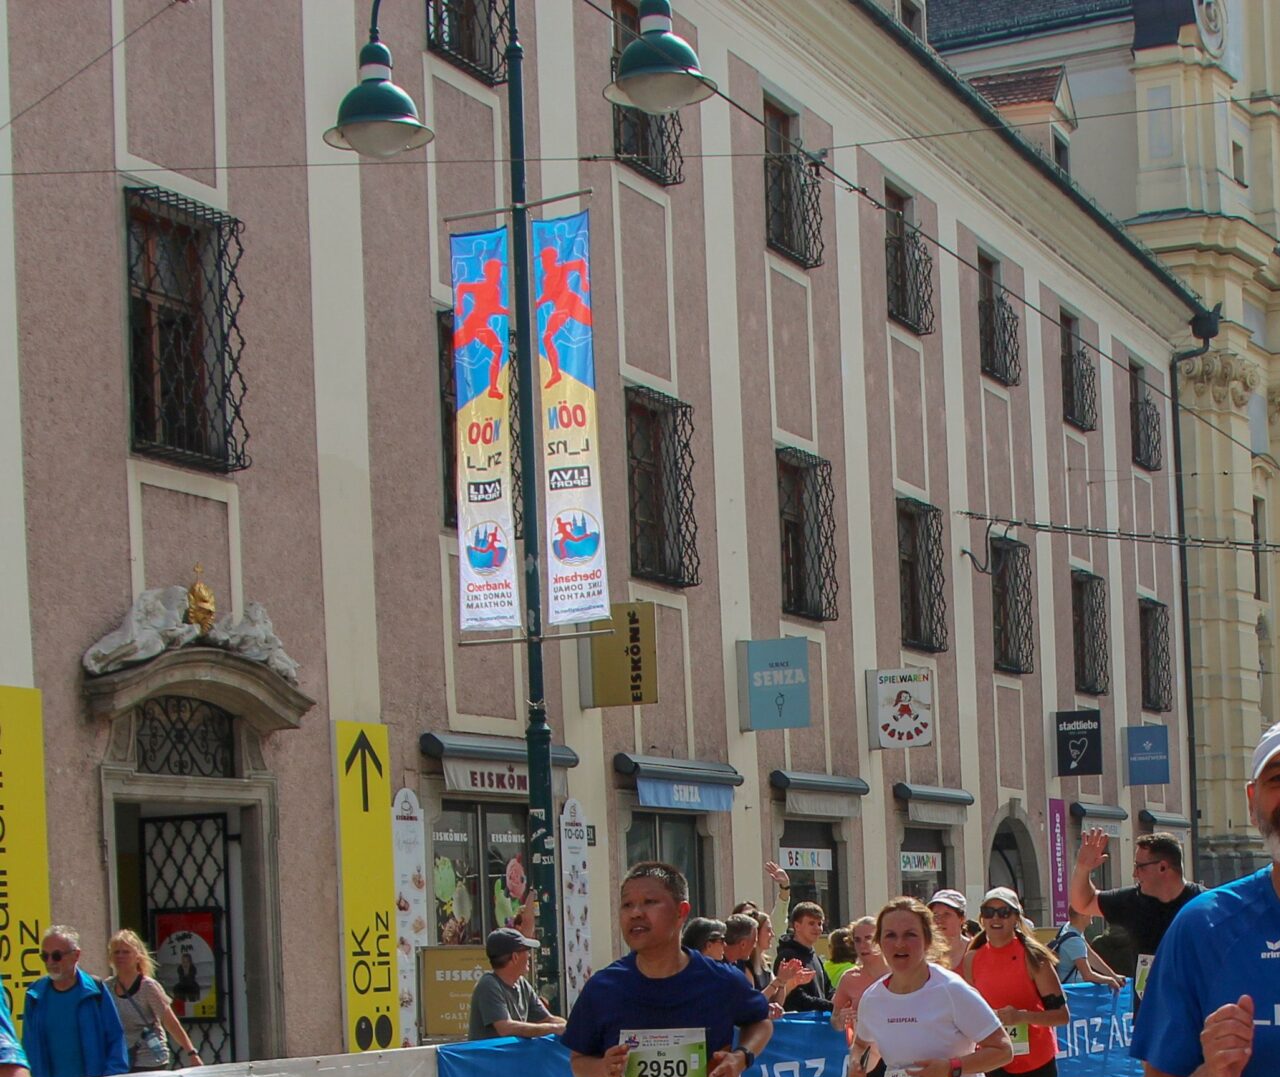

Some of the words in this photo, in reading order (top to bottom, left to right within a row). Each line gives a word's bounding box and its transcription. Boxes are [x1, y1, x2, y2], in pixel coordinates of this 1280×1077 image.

[483, 592, 512, 600] DONAU
[753, 668, 806, 687] SENZA
[879, 673, 929, 684] SPIELWAREN
[1058, 719, 1098, 731] stadtliebe
[470, 765, 528, 790] EISKÖN
[672, 784, 700, 802] SENZA
[491, 830, 526, 843] EISKÖNIG
[564, 828, 584, 840] TO-GO
[1055, 812, 1064, 892] stadtliebe
[352, 926, 371, 994] OK
[373, 911, 391, 992] Linz
[436, 965, 493, 981] EISKÖ
[1005, 1027, 1018, 1038] 4
[1054, 1017, 1104, 1059] LINZ
